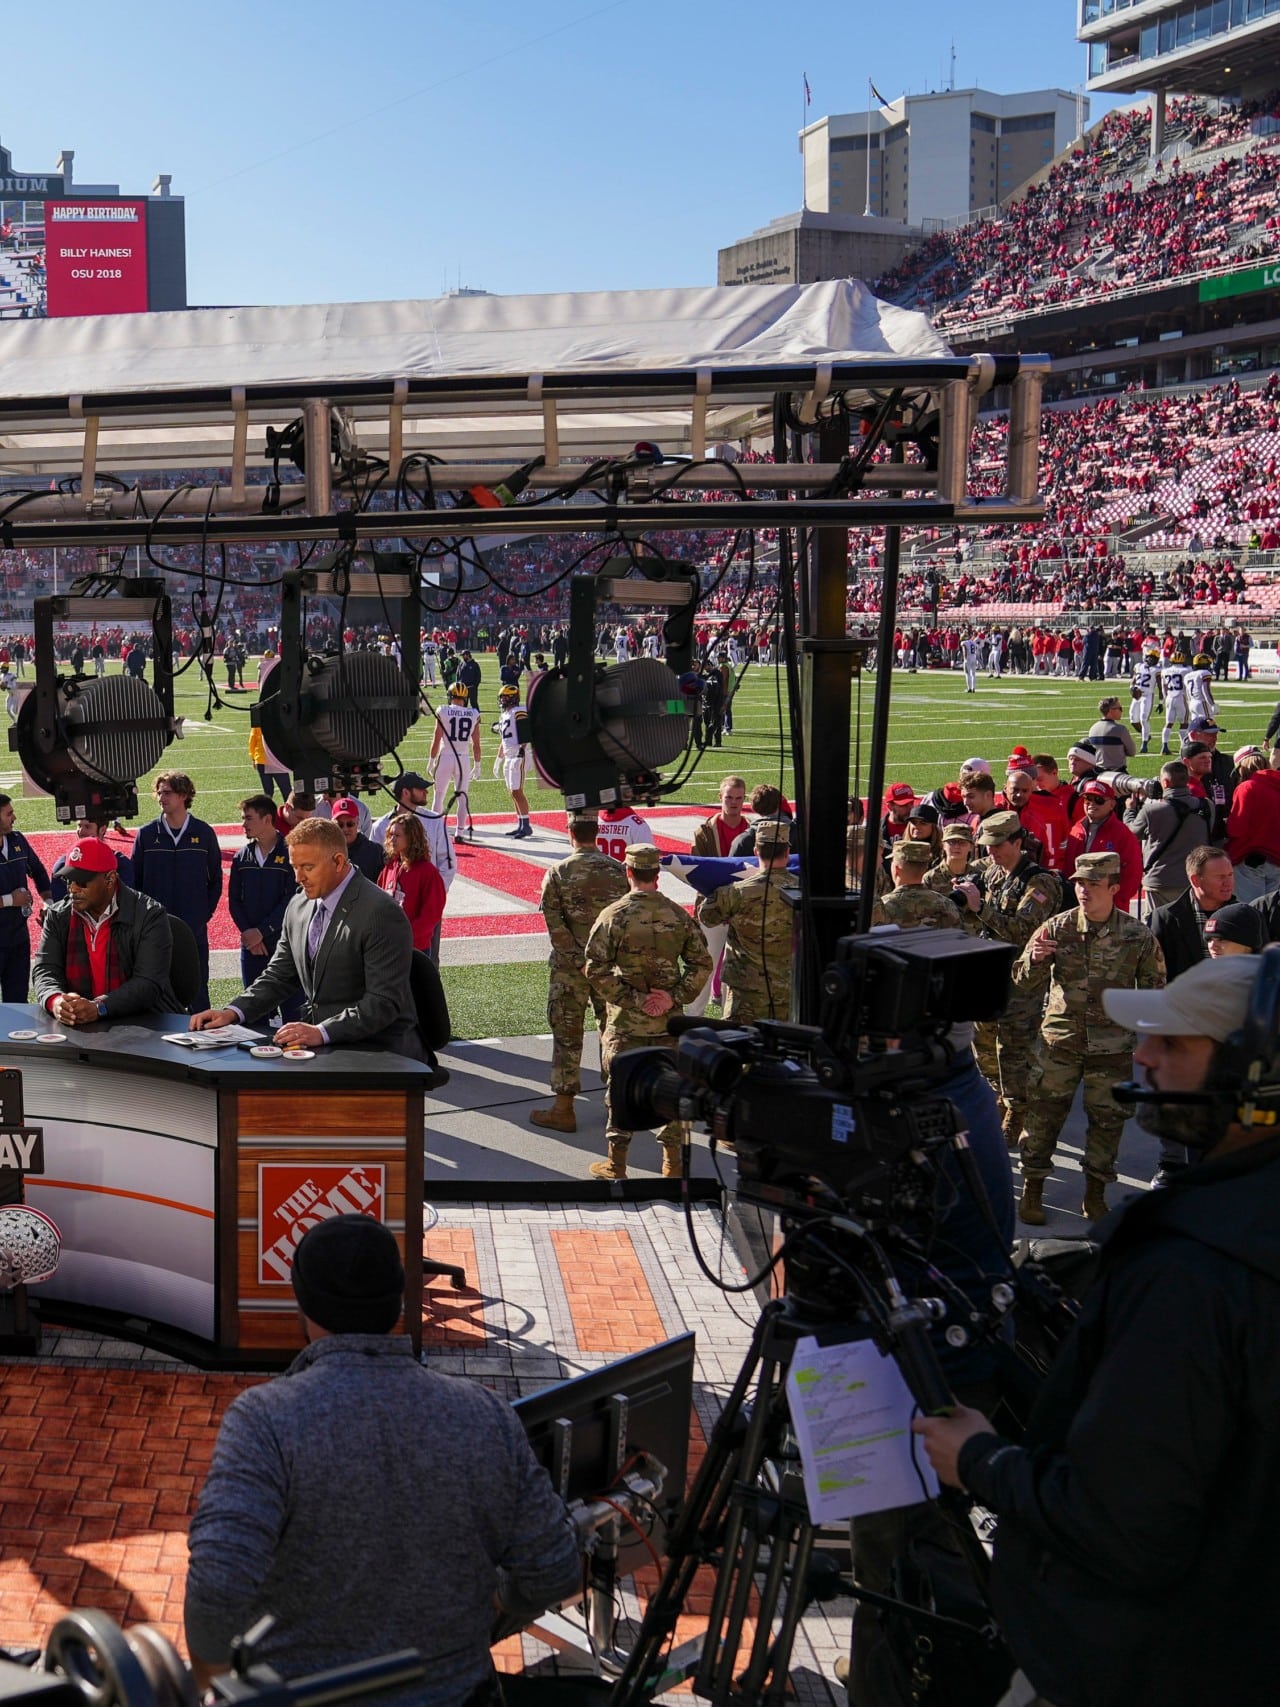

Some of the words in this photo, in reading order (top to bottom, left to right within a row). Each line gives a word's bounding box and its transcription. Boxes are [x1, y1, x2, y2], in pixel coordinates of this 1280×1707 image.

[53, 207, 85, 219] HAPPY
[87, 207, 136, 219] BIRTHDAY
[60, 248, 88, 257] BILLY
[89, 248, 132, 257] HAINES!
[71, 269, 94, 278] OSU
[96, 269, 122, 278] 2018
[1135, 673, 1151, 688] 22
[1165, 673, 1183, 691] 23
[1187, 679, 1195, 697] 7
[448, 716, 472, 742] 18
[273, 1178, 324, 1225] THE
